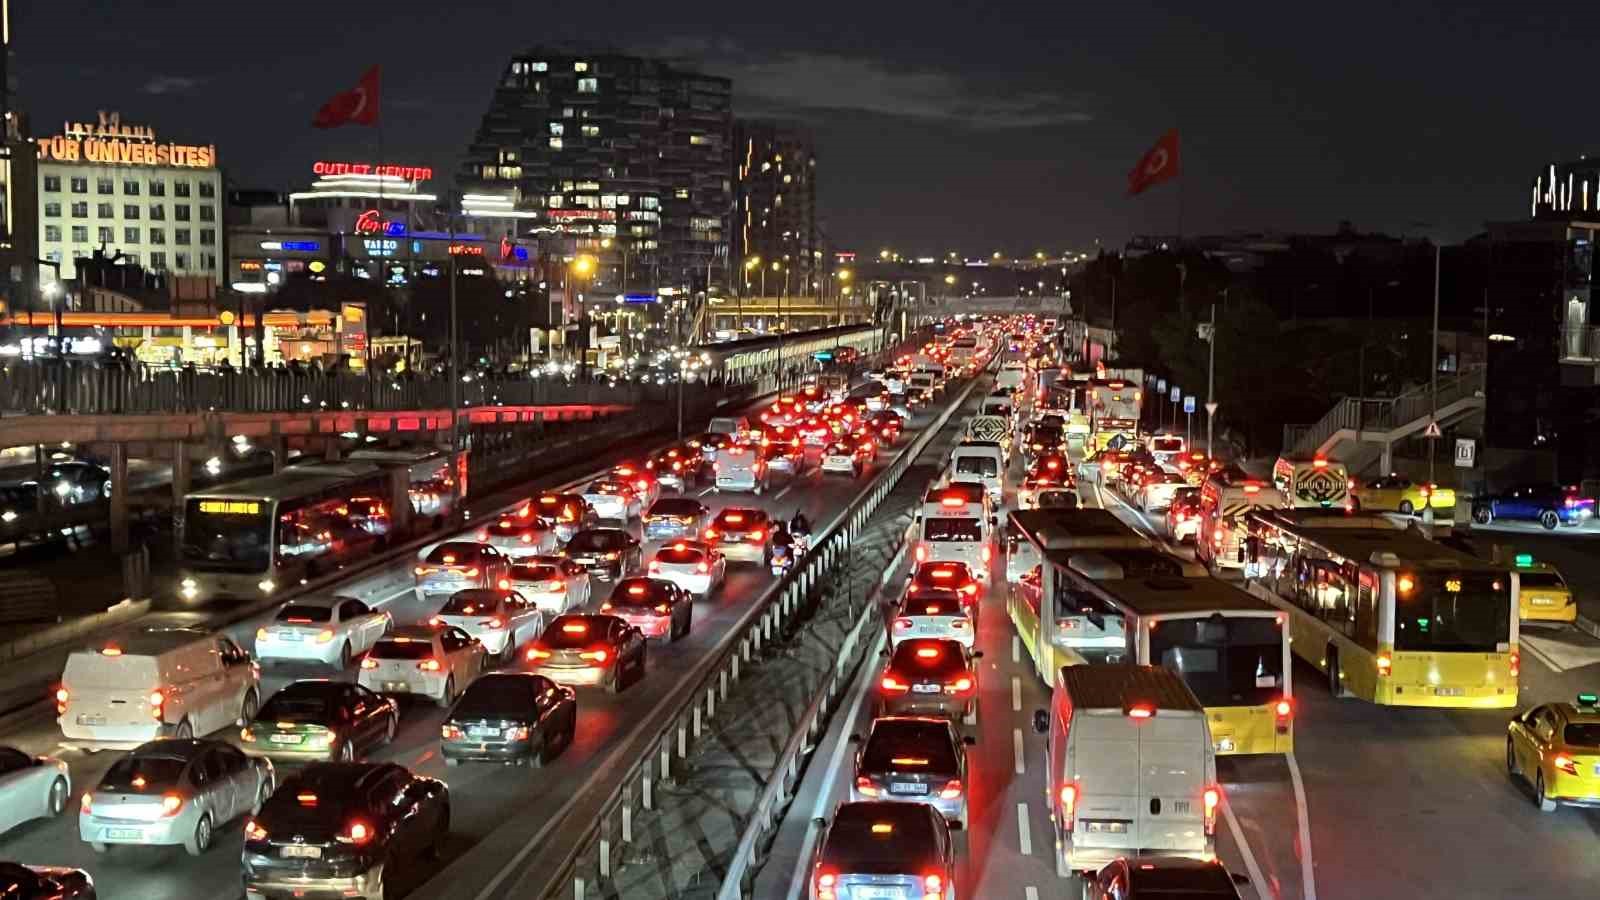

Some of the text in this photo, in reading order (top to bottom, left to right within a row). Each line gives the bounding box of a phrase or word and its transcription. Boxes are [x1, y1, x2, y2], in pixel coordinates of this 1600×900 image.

[84, 138, 216, 168] ÜNİVERSİTESİ
[313, 162, 433, 180] OUTLET CENTER
